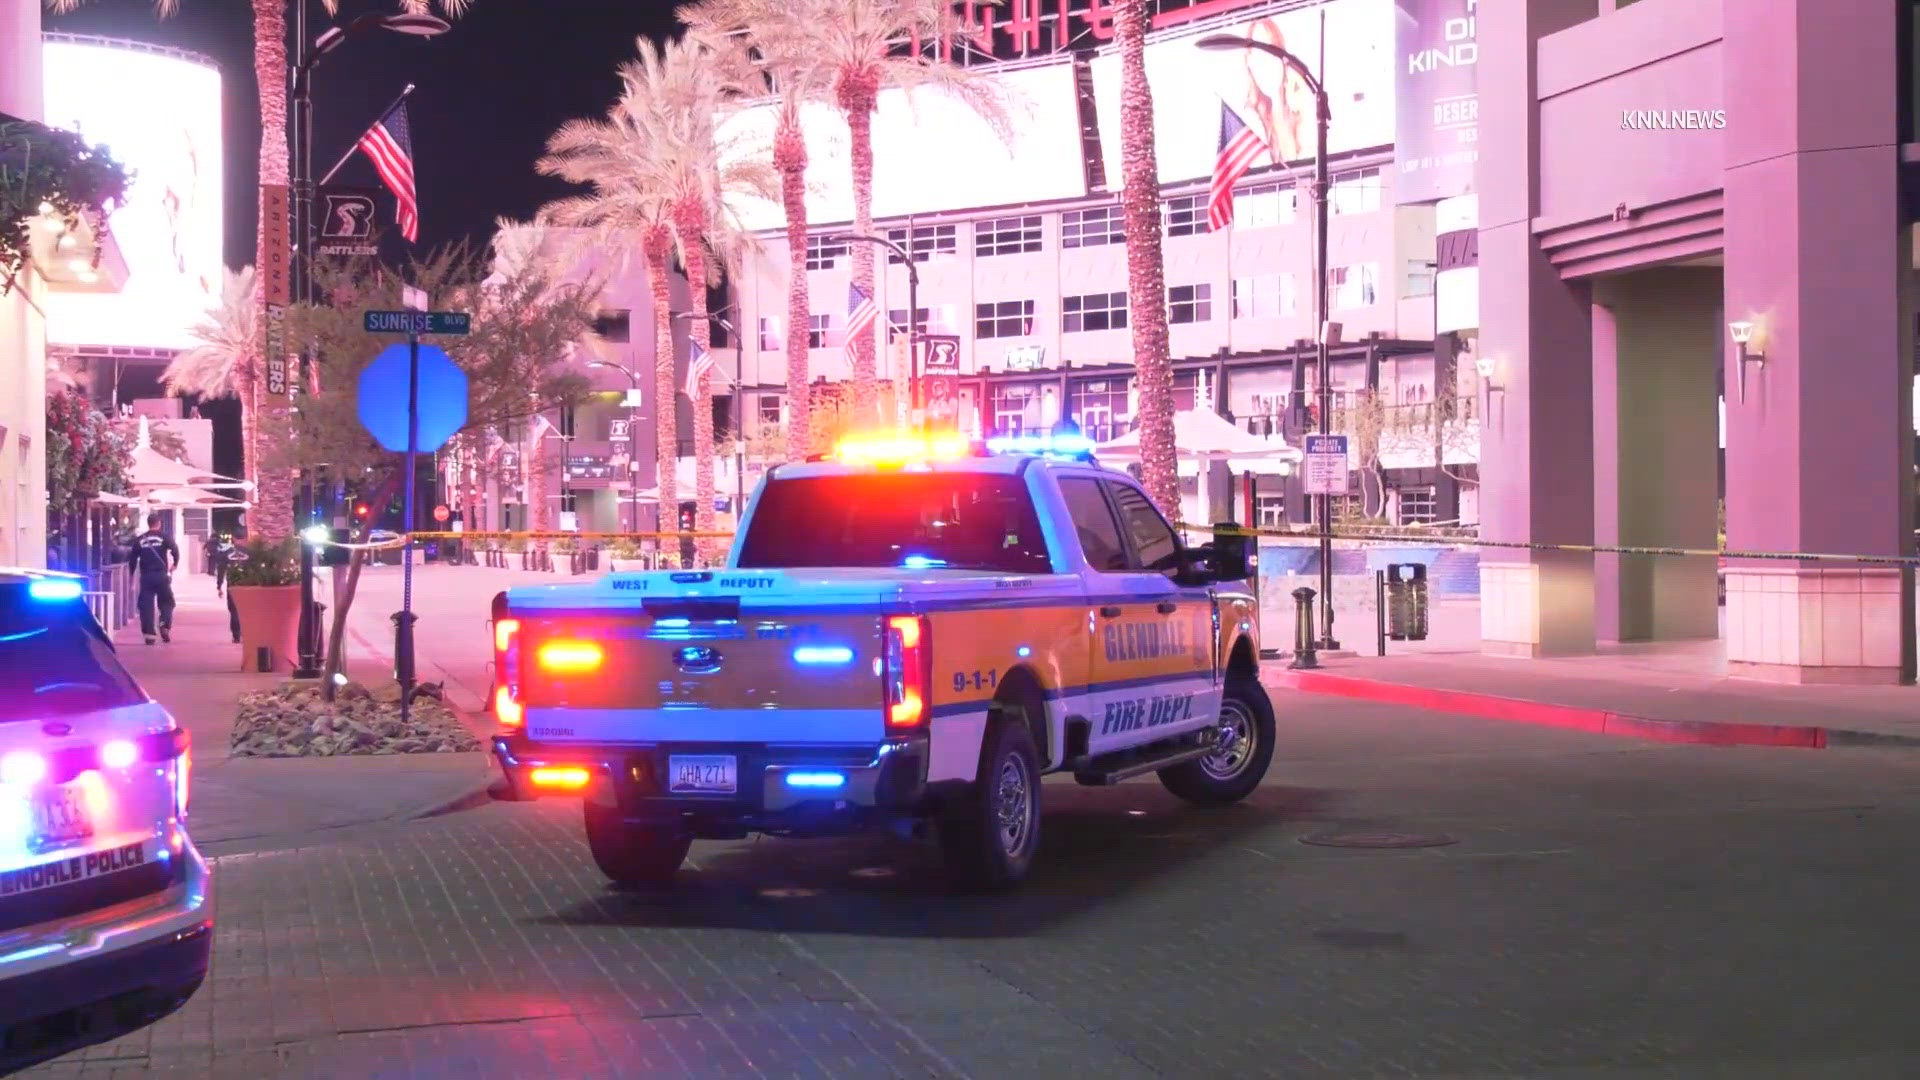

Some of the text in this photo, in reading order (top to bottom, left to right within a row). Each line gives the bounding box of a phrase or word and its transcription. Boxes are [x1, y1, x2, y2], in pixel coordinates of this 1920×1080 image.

[1408, 43, 1478, 75] KIND
[1433, 100, 1478, 126] DESER
[271, 195, 281, 295] ARIZONA
[319, 246, 379, 256] RATTLERS
[369, 313, 466, 331] SUNRISE BLVD
[268, 304, 285, 394] RATTERS
[612, 578, 775, 591] WEST DEPUTY
[1104, 620, 1187, 664] GLENDALE
[953, 668, 997, 692] 9-1-1
[1101, 694, 1194, 735] FIRE DEPT.
[705, 764, 728, 784] 271
[86, 842, 145, 876] POLICE
